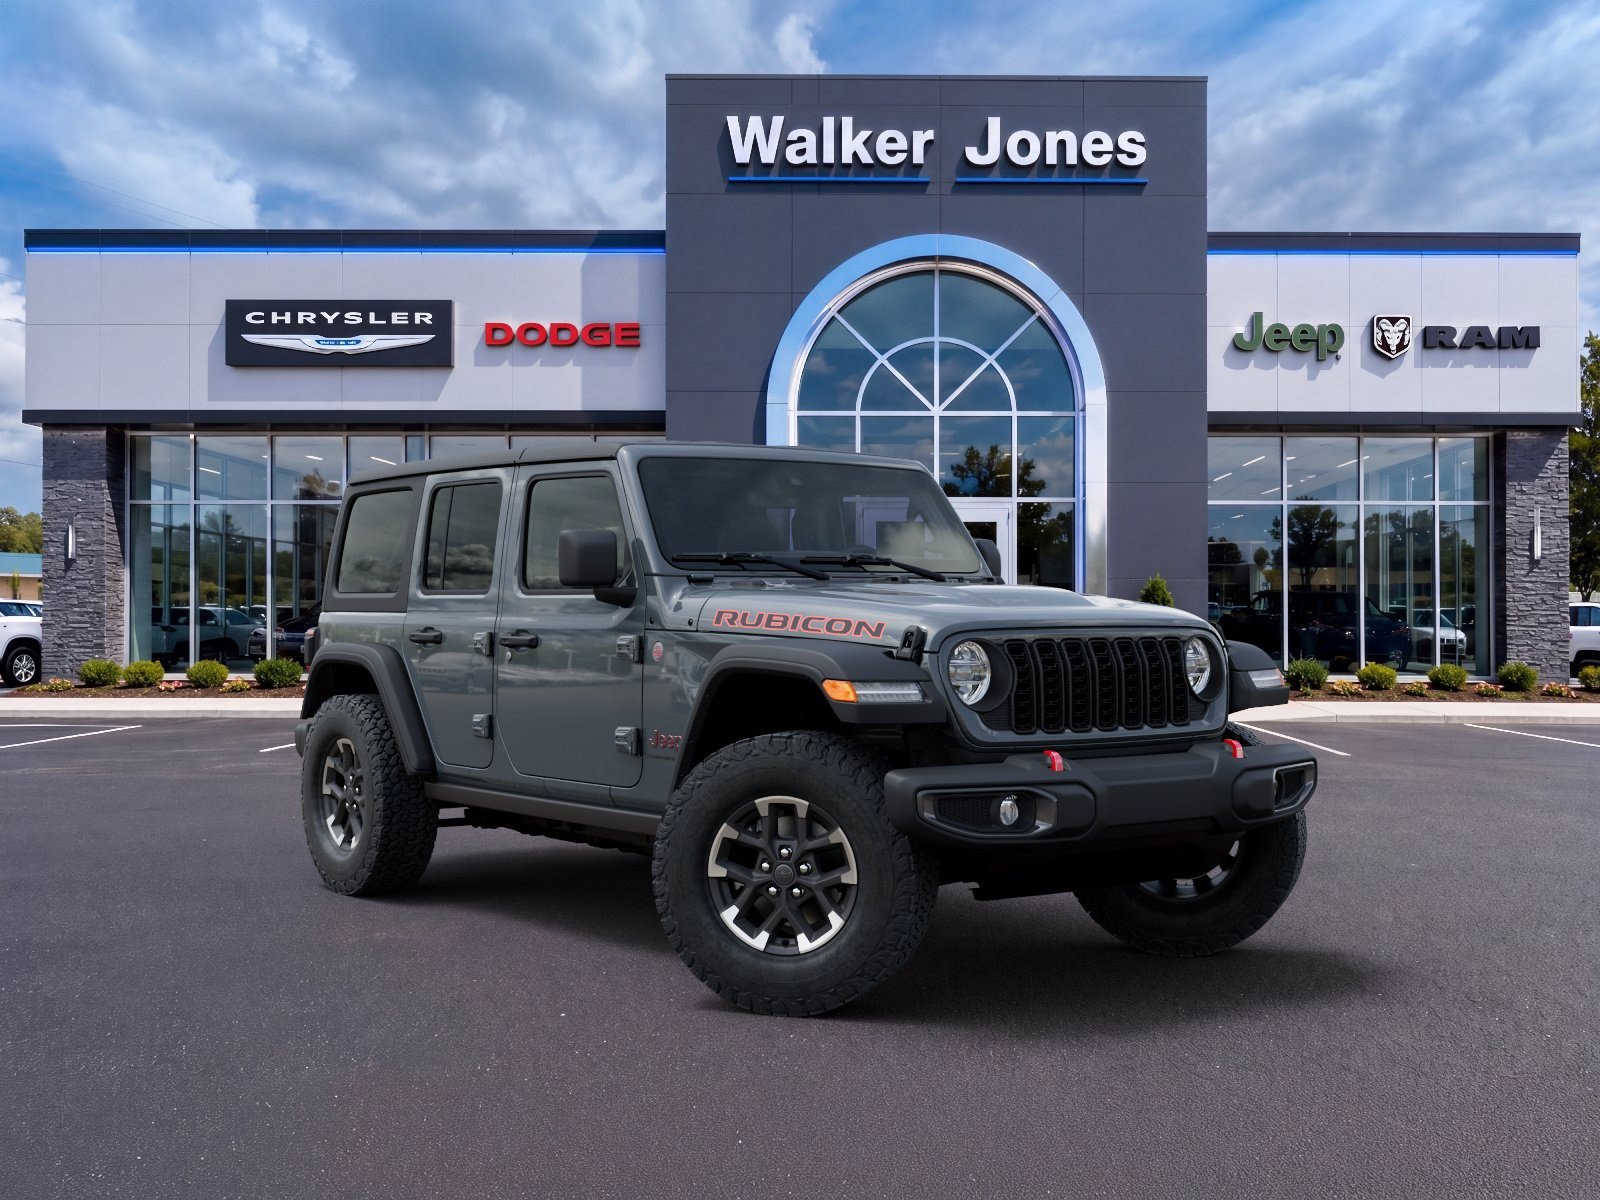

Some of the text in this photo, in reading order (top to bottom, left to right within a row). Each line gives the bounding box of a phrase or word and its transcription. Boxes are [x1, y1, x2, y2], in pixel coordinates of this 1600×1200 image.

[726, 115, 1148, 167] Walker Jones
[245, 311, 433, 325] CHRYSLER
[485, 322, 641, 347] DODGE
[1233, 311, 1345, 361] Jeep
[1423, 325, 1541, 349] RAM
[712, 608, 888, 640] RUBICON
